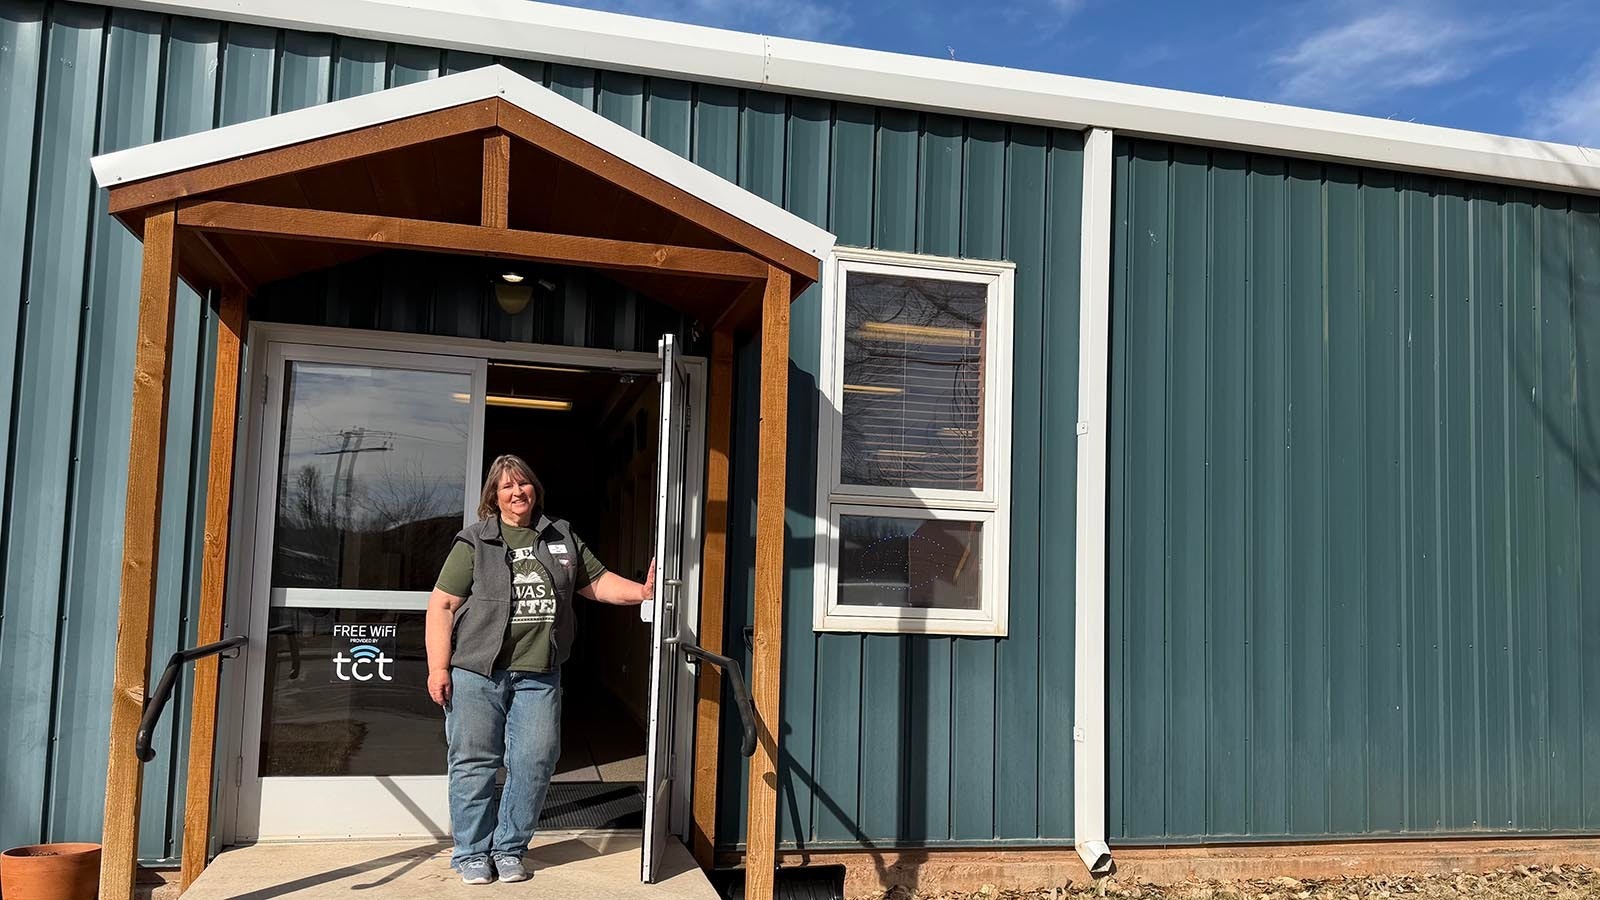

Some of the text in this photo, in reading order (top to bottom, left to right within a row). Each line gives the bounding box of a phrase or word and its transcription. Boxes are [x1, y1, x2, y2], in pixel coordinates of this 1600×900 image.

[515, 599, 556, 614] TTE
[333, 625, 396, 637] FREE WiFi
[333, 651, 393, 681] tct
